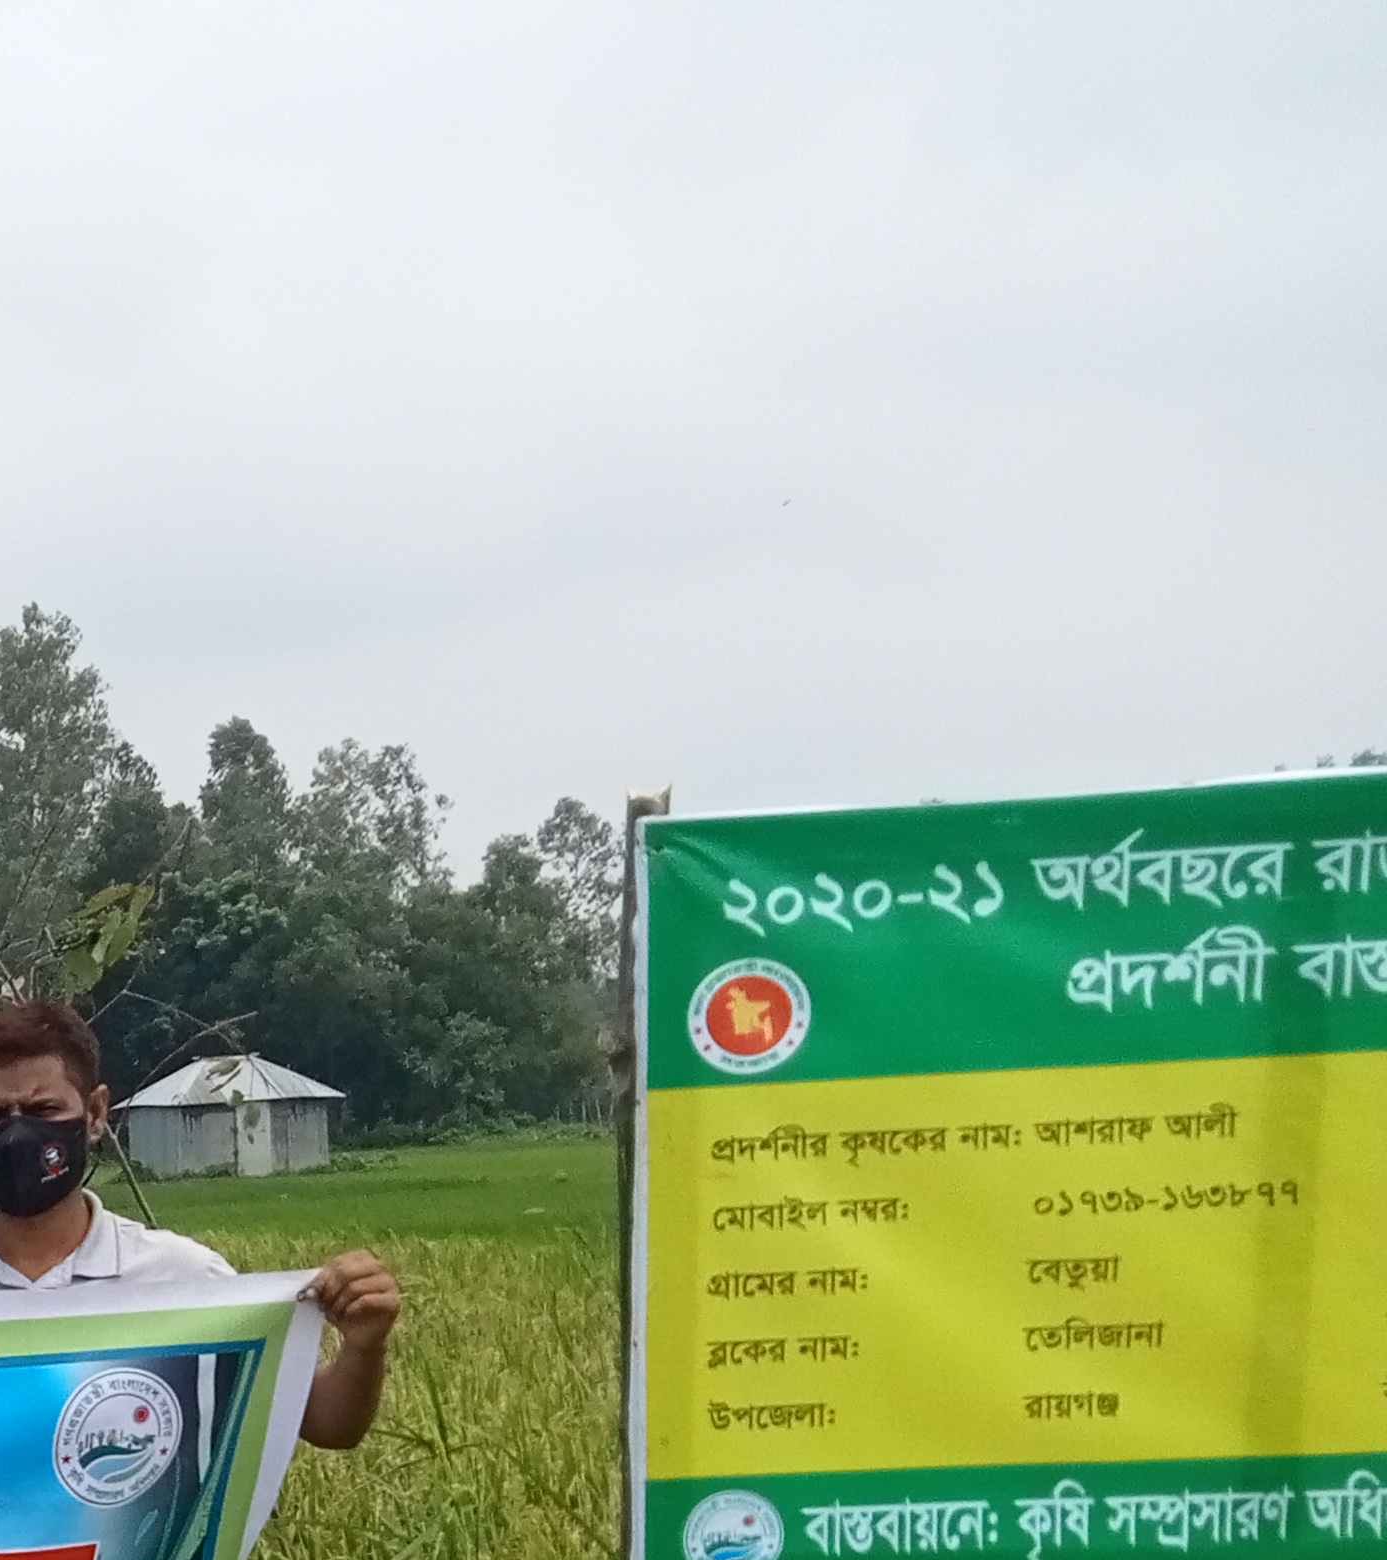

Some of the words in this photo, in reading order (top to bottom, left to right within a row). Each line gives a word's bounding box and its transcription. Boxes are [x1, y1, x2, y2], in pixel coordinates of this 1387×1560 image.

[723, 860, 1003, 937] ২০২০-২১
[1030, 828, 1294, 911] অর্থবছরে
[1312, 828, 1387, 893] রা
[1067, 924, 1278, 1013] প্রদর্শনী
[711, 1123, 829, 1164] প্রদর্শনীর
[839, 1127, 947, 1168] কৃষকের
[1034, 1116, 1155, 1147] আশরাফ
[1164, 1101, 1240, 1143] আলী
[713, 1195, 829, 1231] মোবাইল
[707, 1269, 798, 1299] গ্রামের
[707, 1337, 787, 1369] ব্লকের
[1022, 1316, 1164, 1351] তেলিজানা
[1103, 1484, 1295, 1552] সম্প্রসারণ
